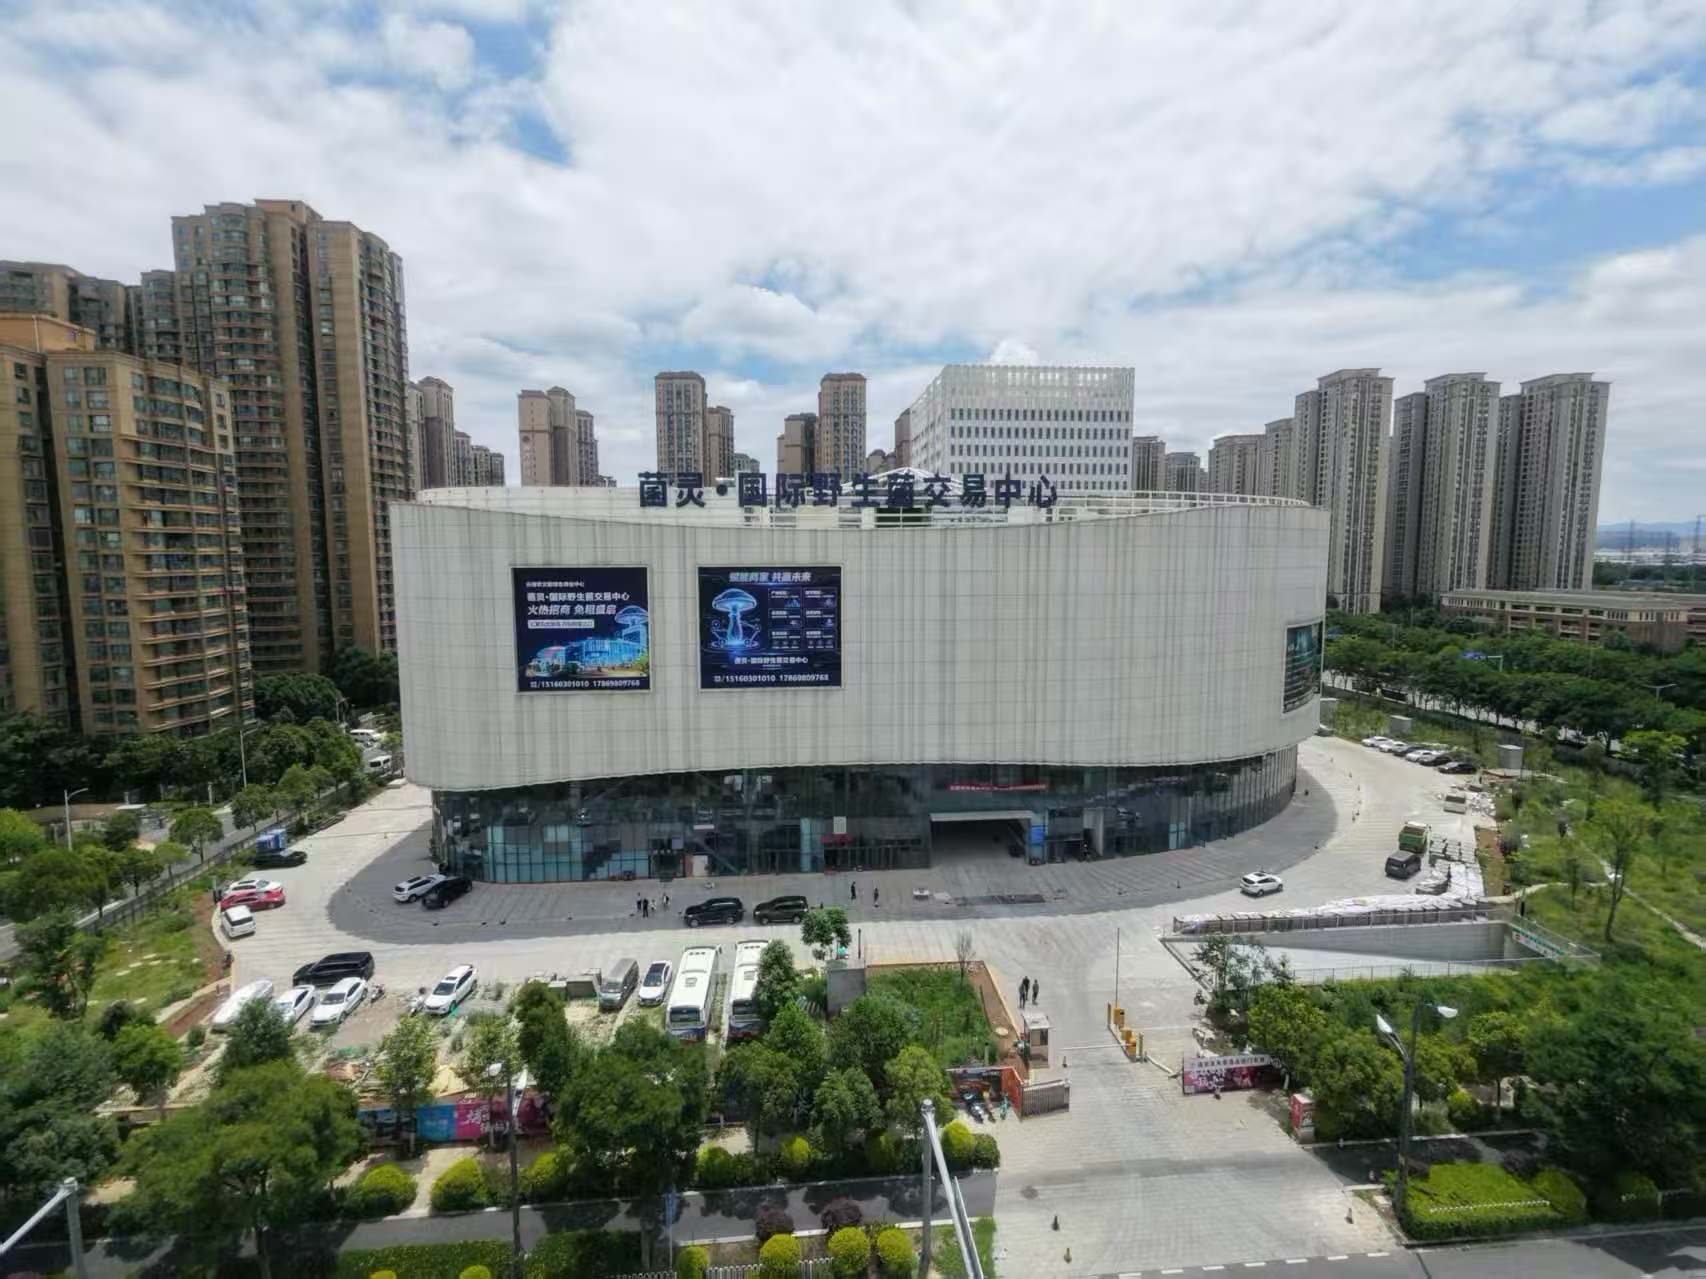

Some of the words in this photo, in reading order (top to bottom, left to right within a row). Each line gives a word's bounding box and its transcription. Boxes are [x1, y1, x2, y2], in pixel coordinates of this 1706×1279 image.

[638, 471, 1058, 508] 菌灵·国际野生菌交易中心
